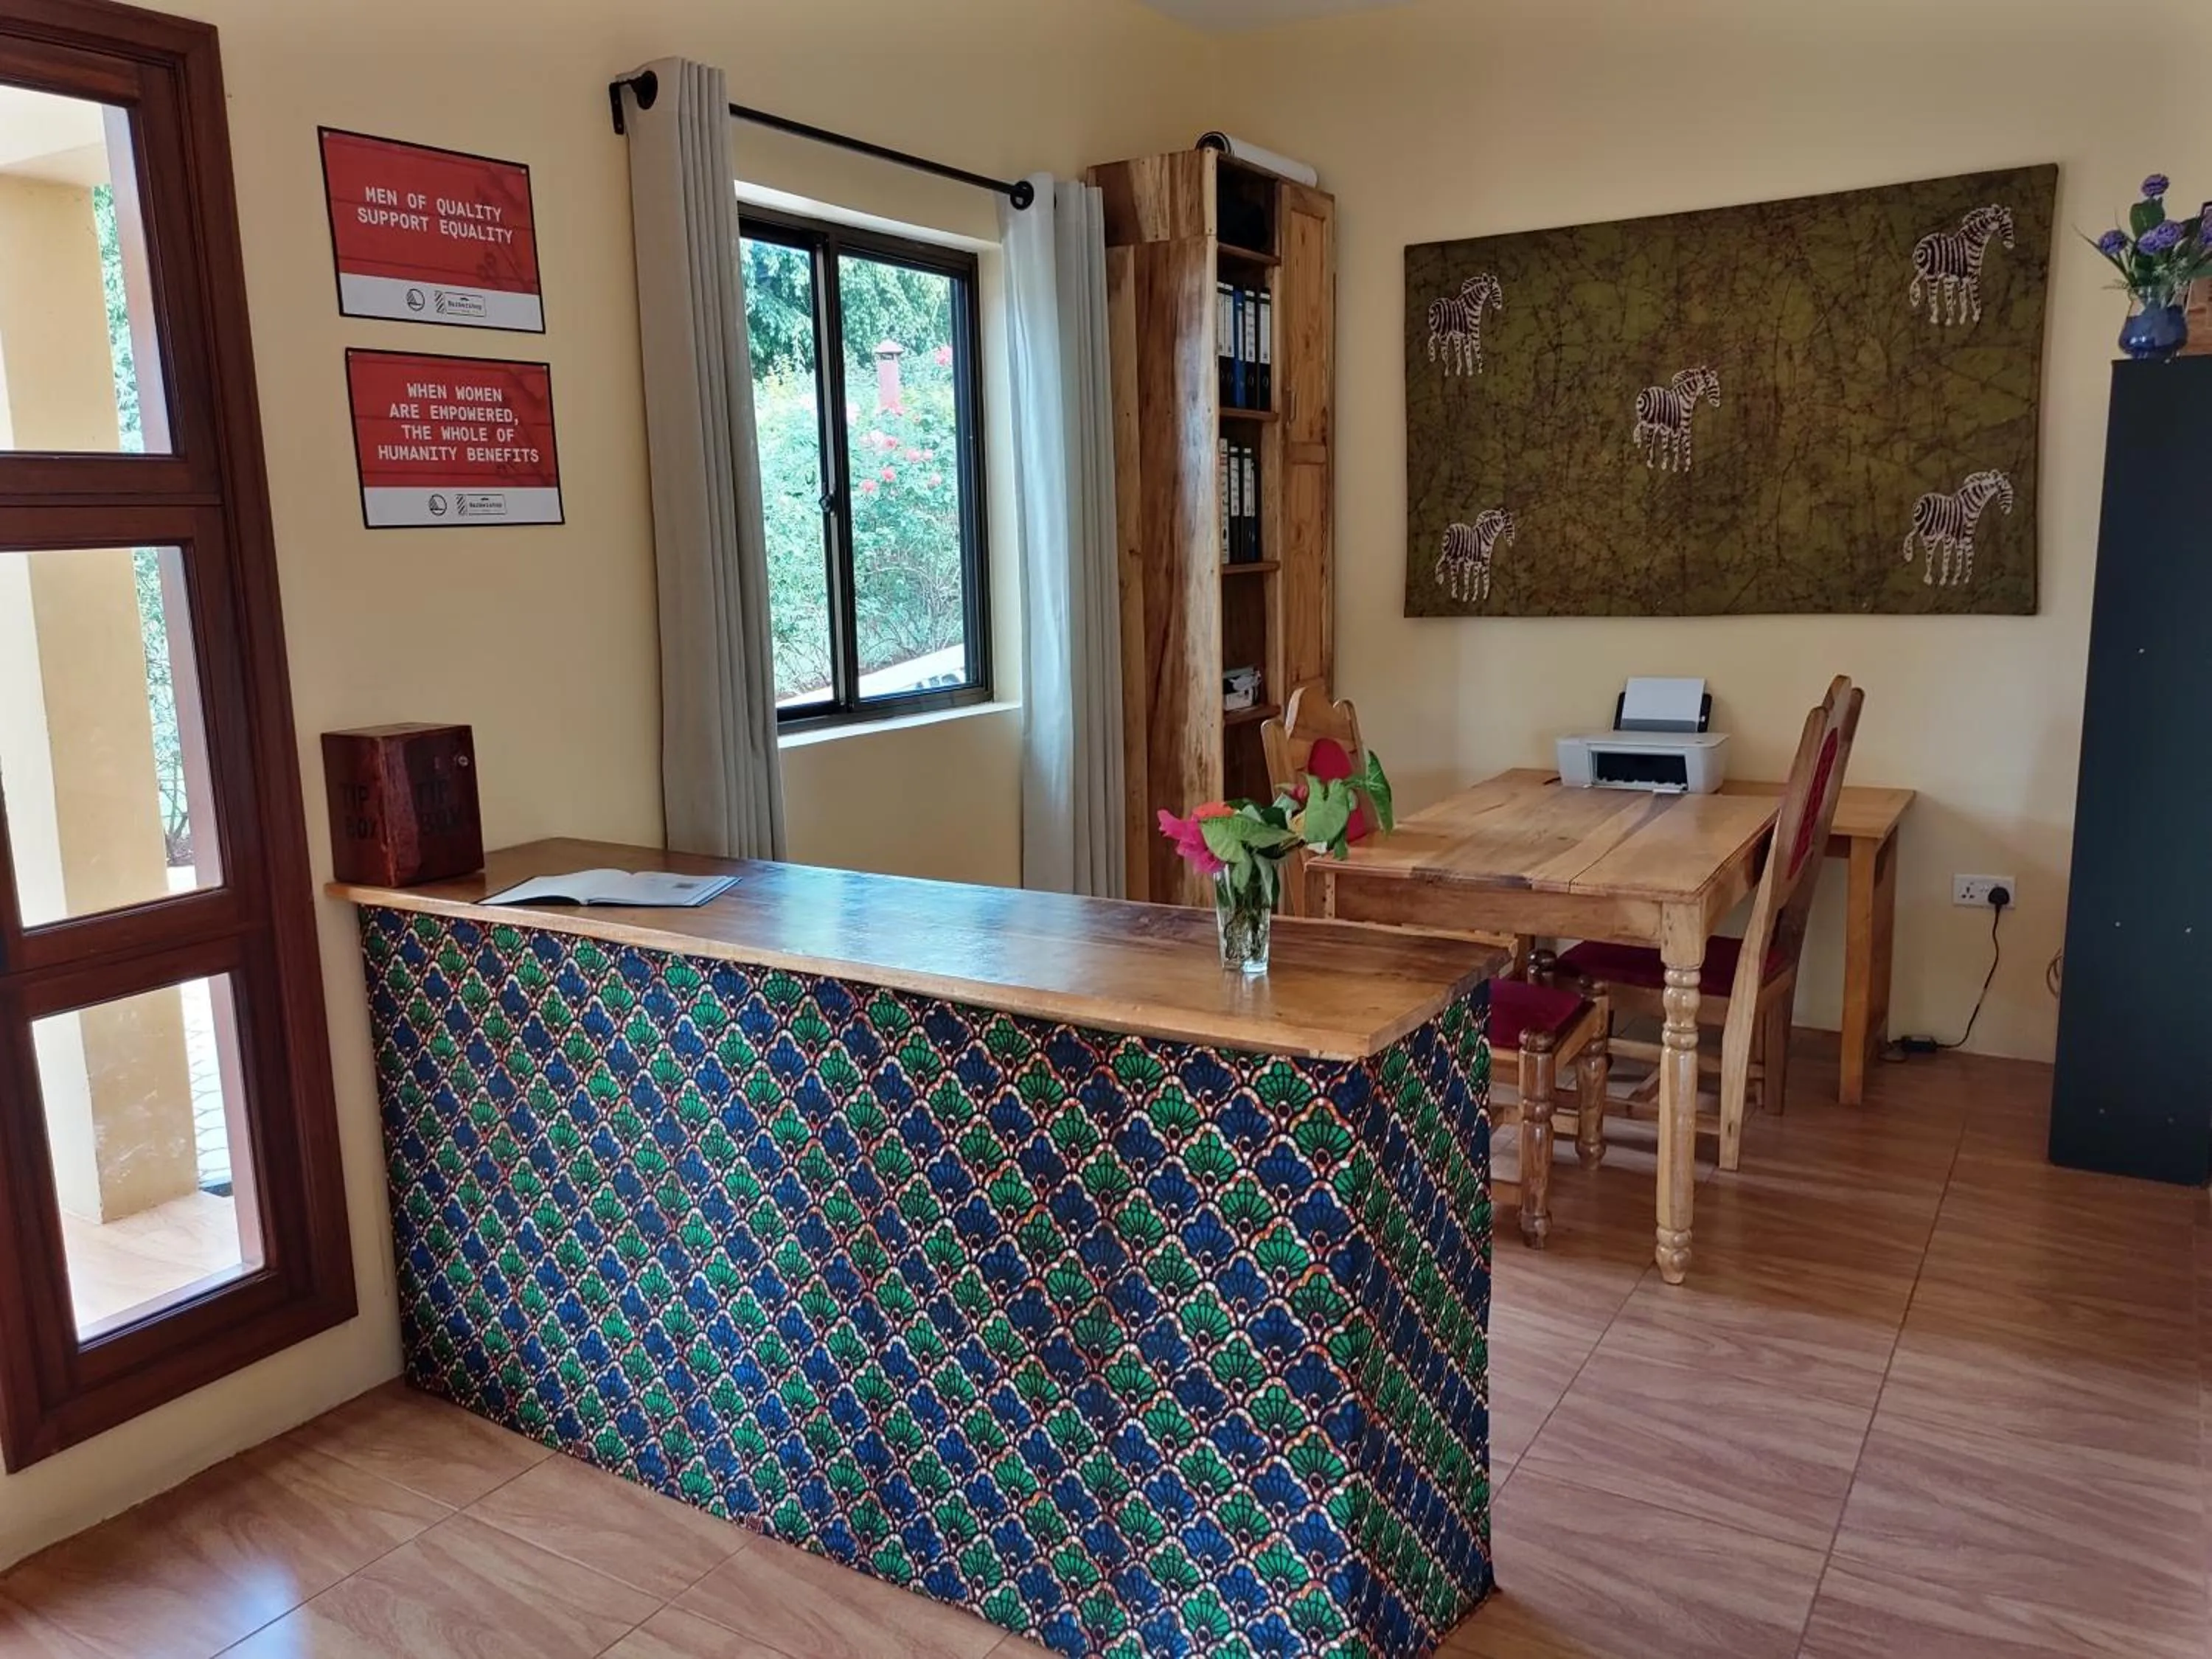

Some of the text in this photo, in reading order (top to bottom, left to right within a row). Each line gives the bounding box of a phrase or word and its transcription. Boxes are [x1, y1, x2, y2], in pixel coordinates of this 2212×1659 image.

[365, 187, 502, 223] MEN OF QUALITY
[357, 206, 513, 245] SUPPORT EQUALITY
[406, 383, 503, 402] WHEN WOMEN
[389, 403, 519, 426] ARE EMPOWERED,
[401, 424, 515, 442] THE WHOLE OF
[378, 445, 540, 462] HUMANITY BENEFITS
